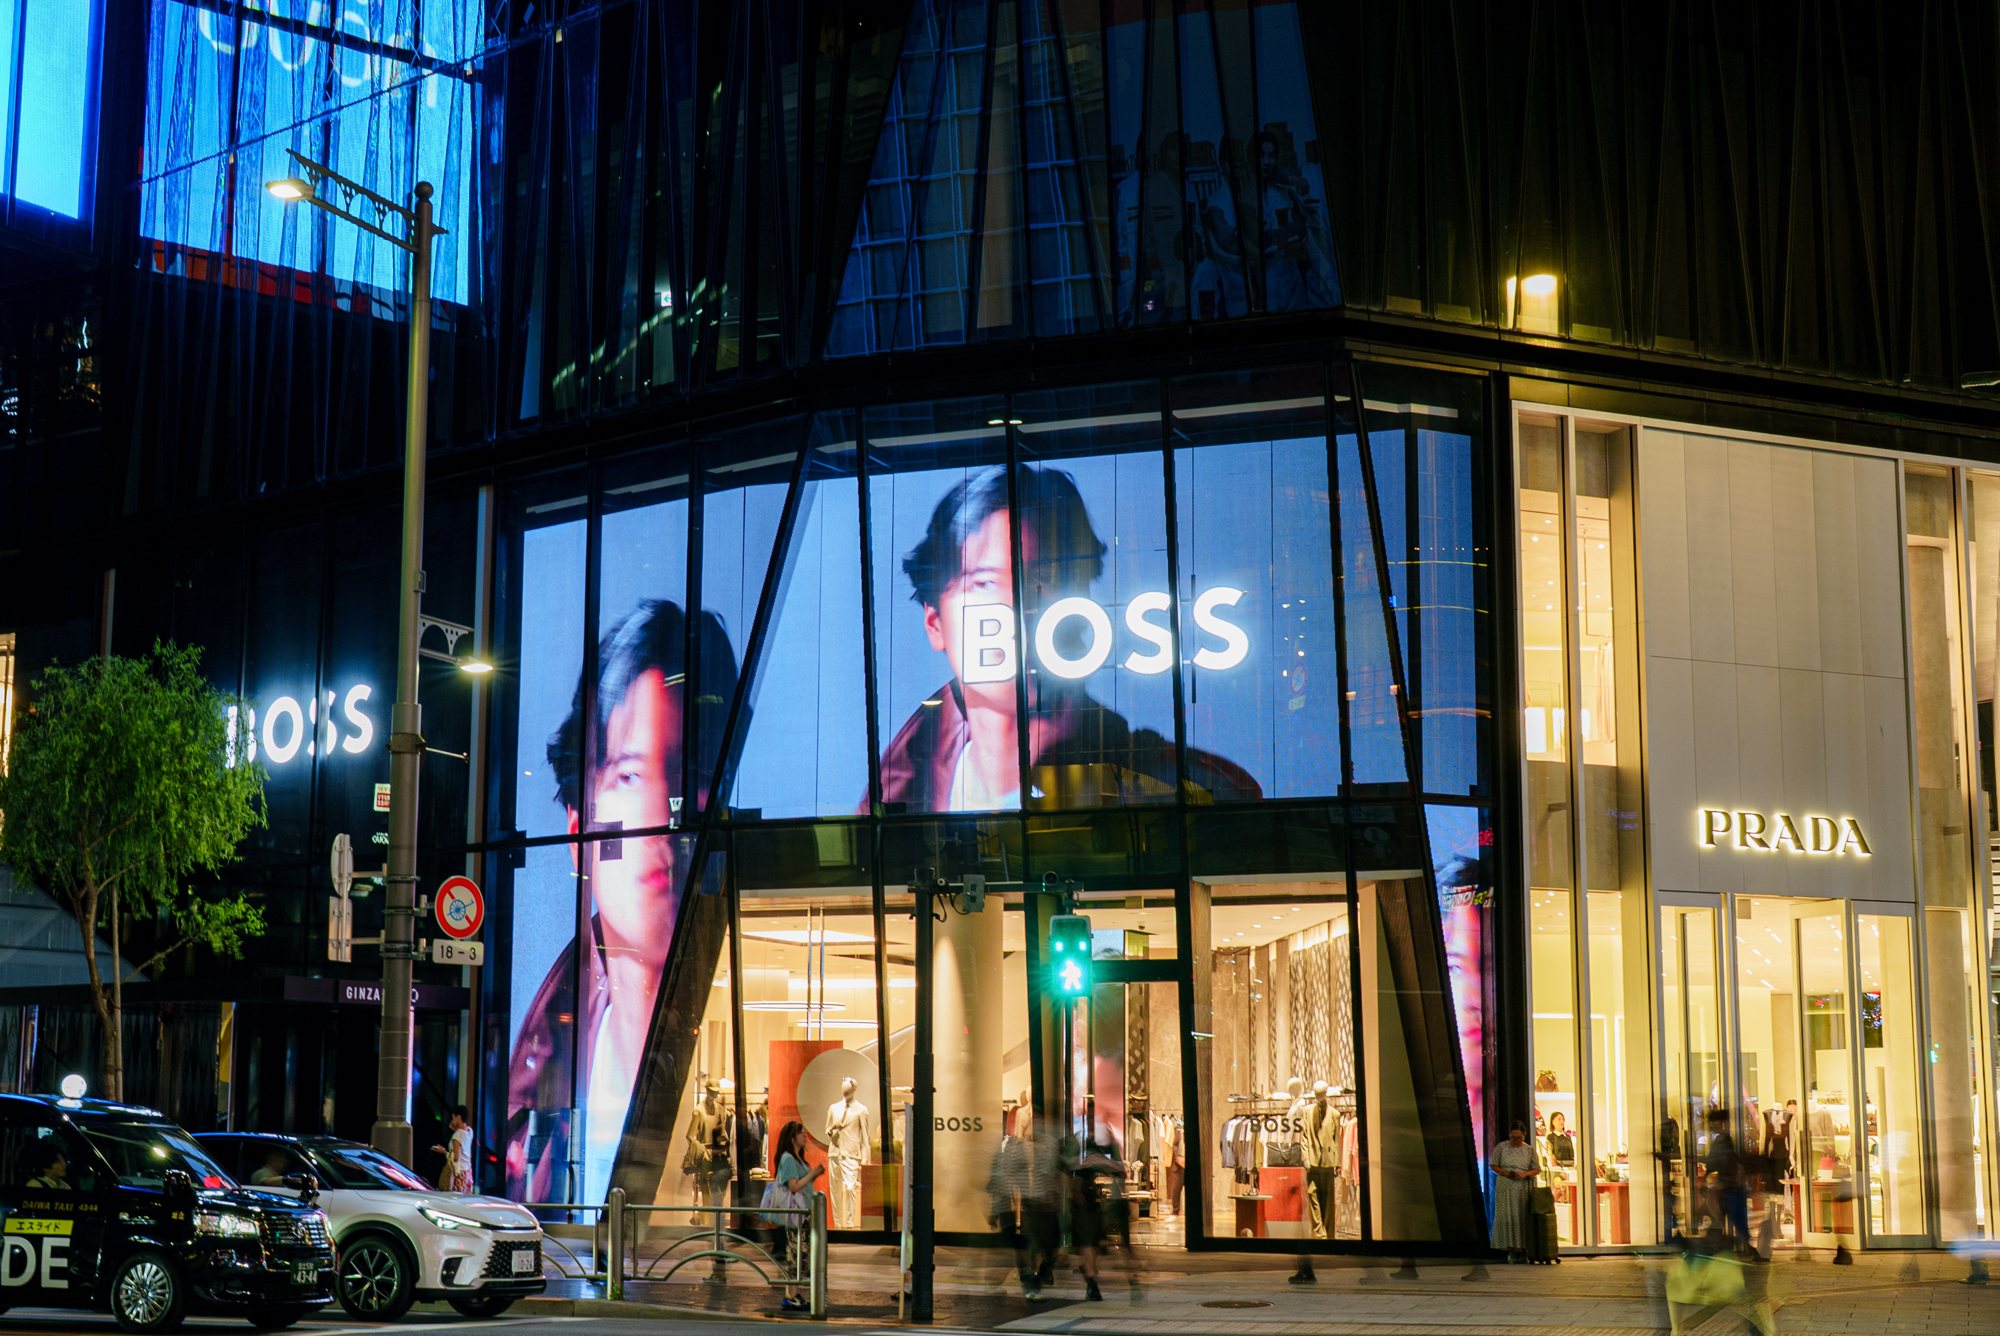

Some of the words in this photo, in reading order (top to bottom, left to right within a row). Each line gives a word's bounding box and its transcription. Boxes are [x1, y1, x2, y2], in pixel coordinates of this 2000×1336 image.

[963, 586, 1249, 685] BOSS
[1698, 808, 1874, 857] PRADA
[345, 985, 381, 1001] GINZA
[934, 1116, 983, 1132] BOSS
[1250, 1117, 1304, 1133] BOSS
[22, 1200, 51, 1210] DAIWA
[54, 1202, 74, 1212] TAXI
